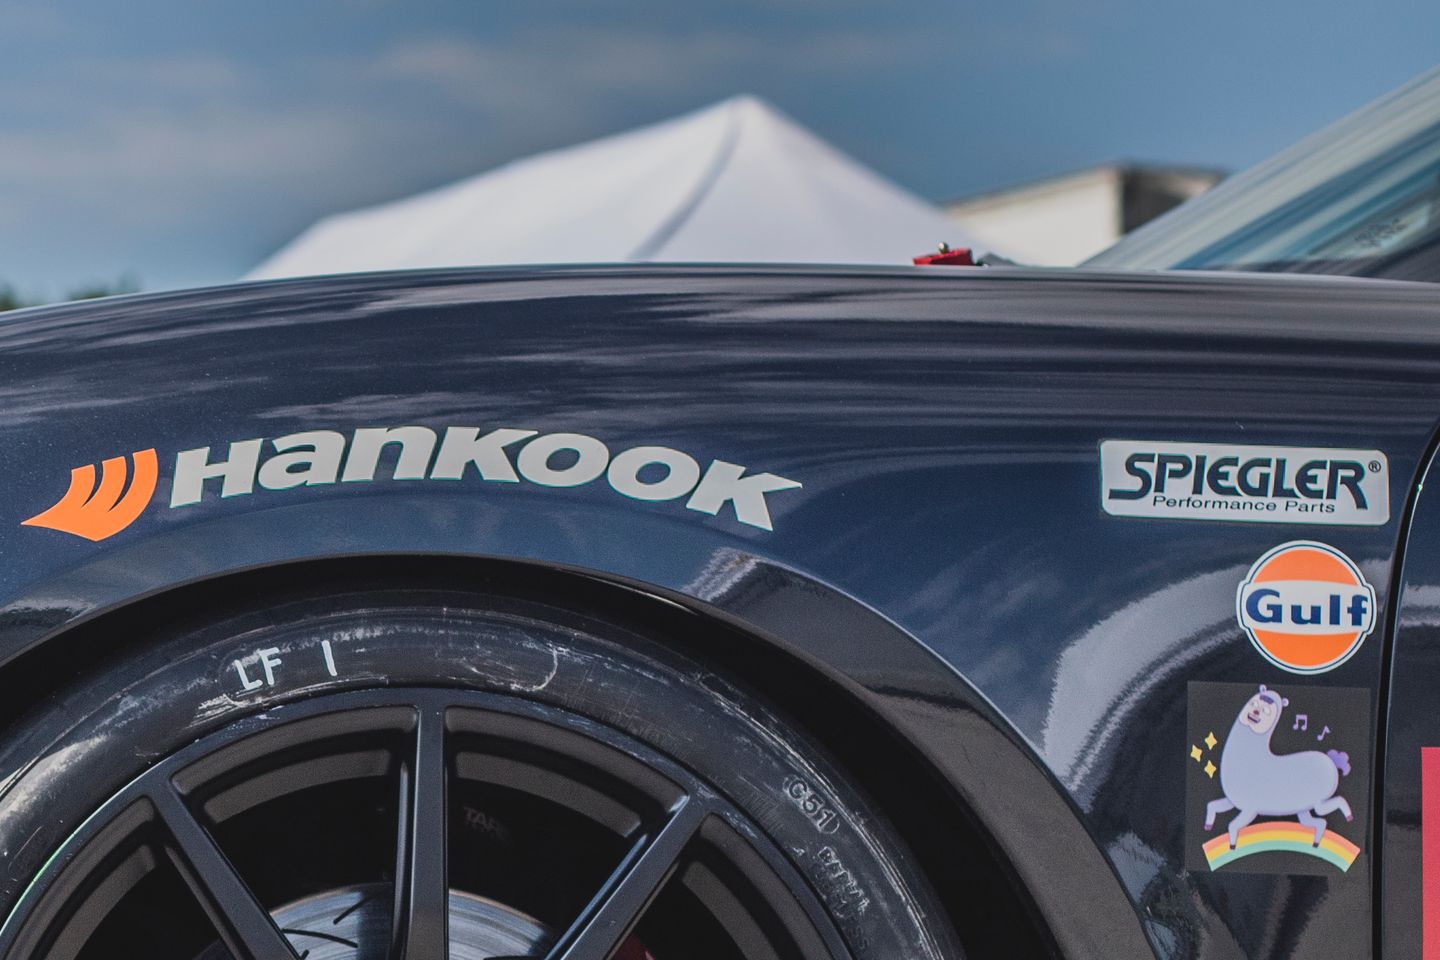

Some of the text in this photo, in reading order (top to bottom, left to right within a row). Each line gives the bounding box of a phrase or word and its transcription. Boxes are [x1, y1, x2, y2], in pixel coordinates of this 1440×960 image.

[1108, 452, 1369, 510] SPIEGLER
[1153, 495, 1336, 514] Performance Parts
[1245, 588, 1369, 627] Gulf
[233, 647, 283, 691] LF
